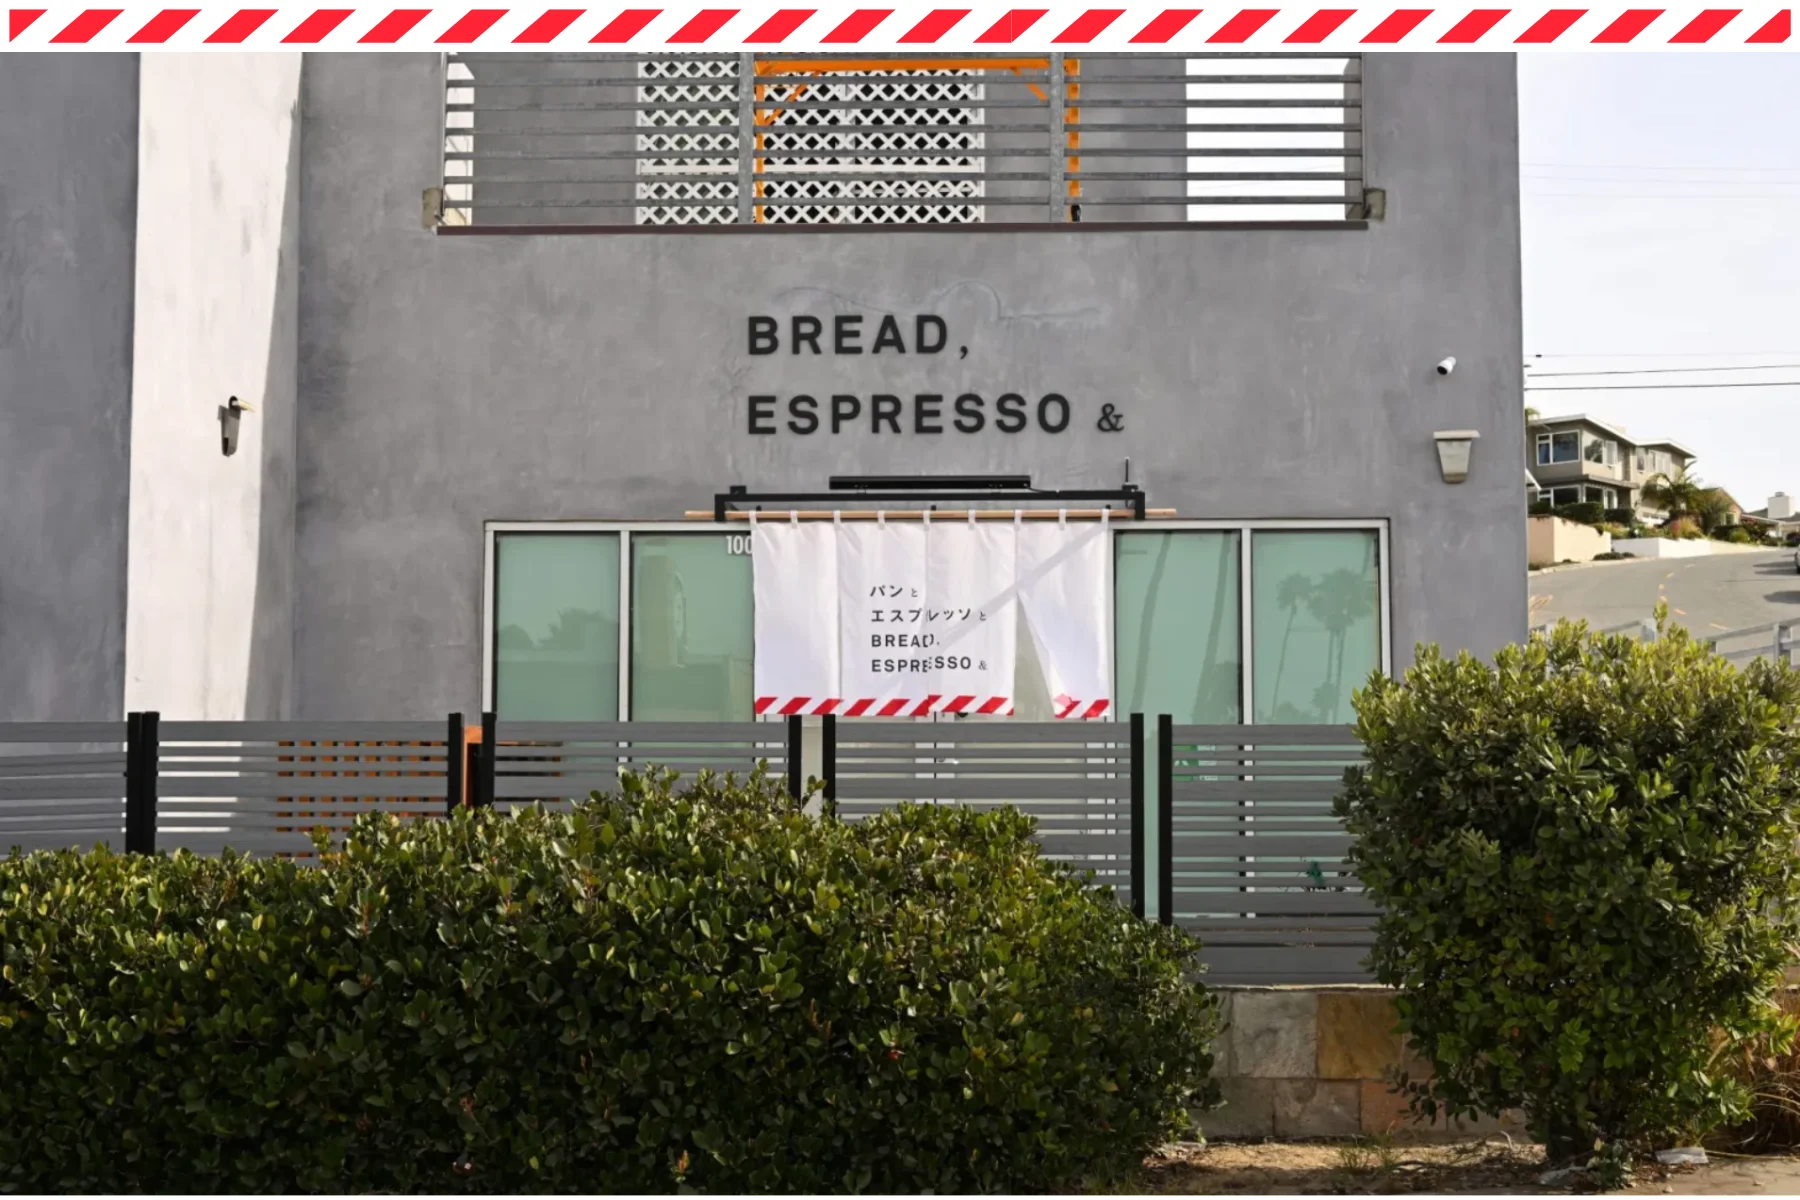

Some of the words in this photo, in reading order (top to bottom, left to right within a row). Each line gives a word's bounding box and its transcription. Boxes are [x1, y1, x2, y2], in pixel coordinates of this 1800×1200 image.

[748, 315, 969, 360] BREAD,
[748, 393, 1071, 434] ESPRESSO
[1096, 403, 1125, 432] &
[871, 655, 972, 673] ESPRESSO
[978, 660, 988, 671] &
